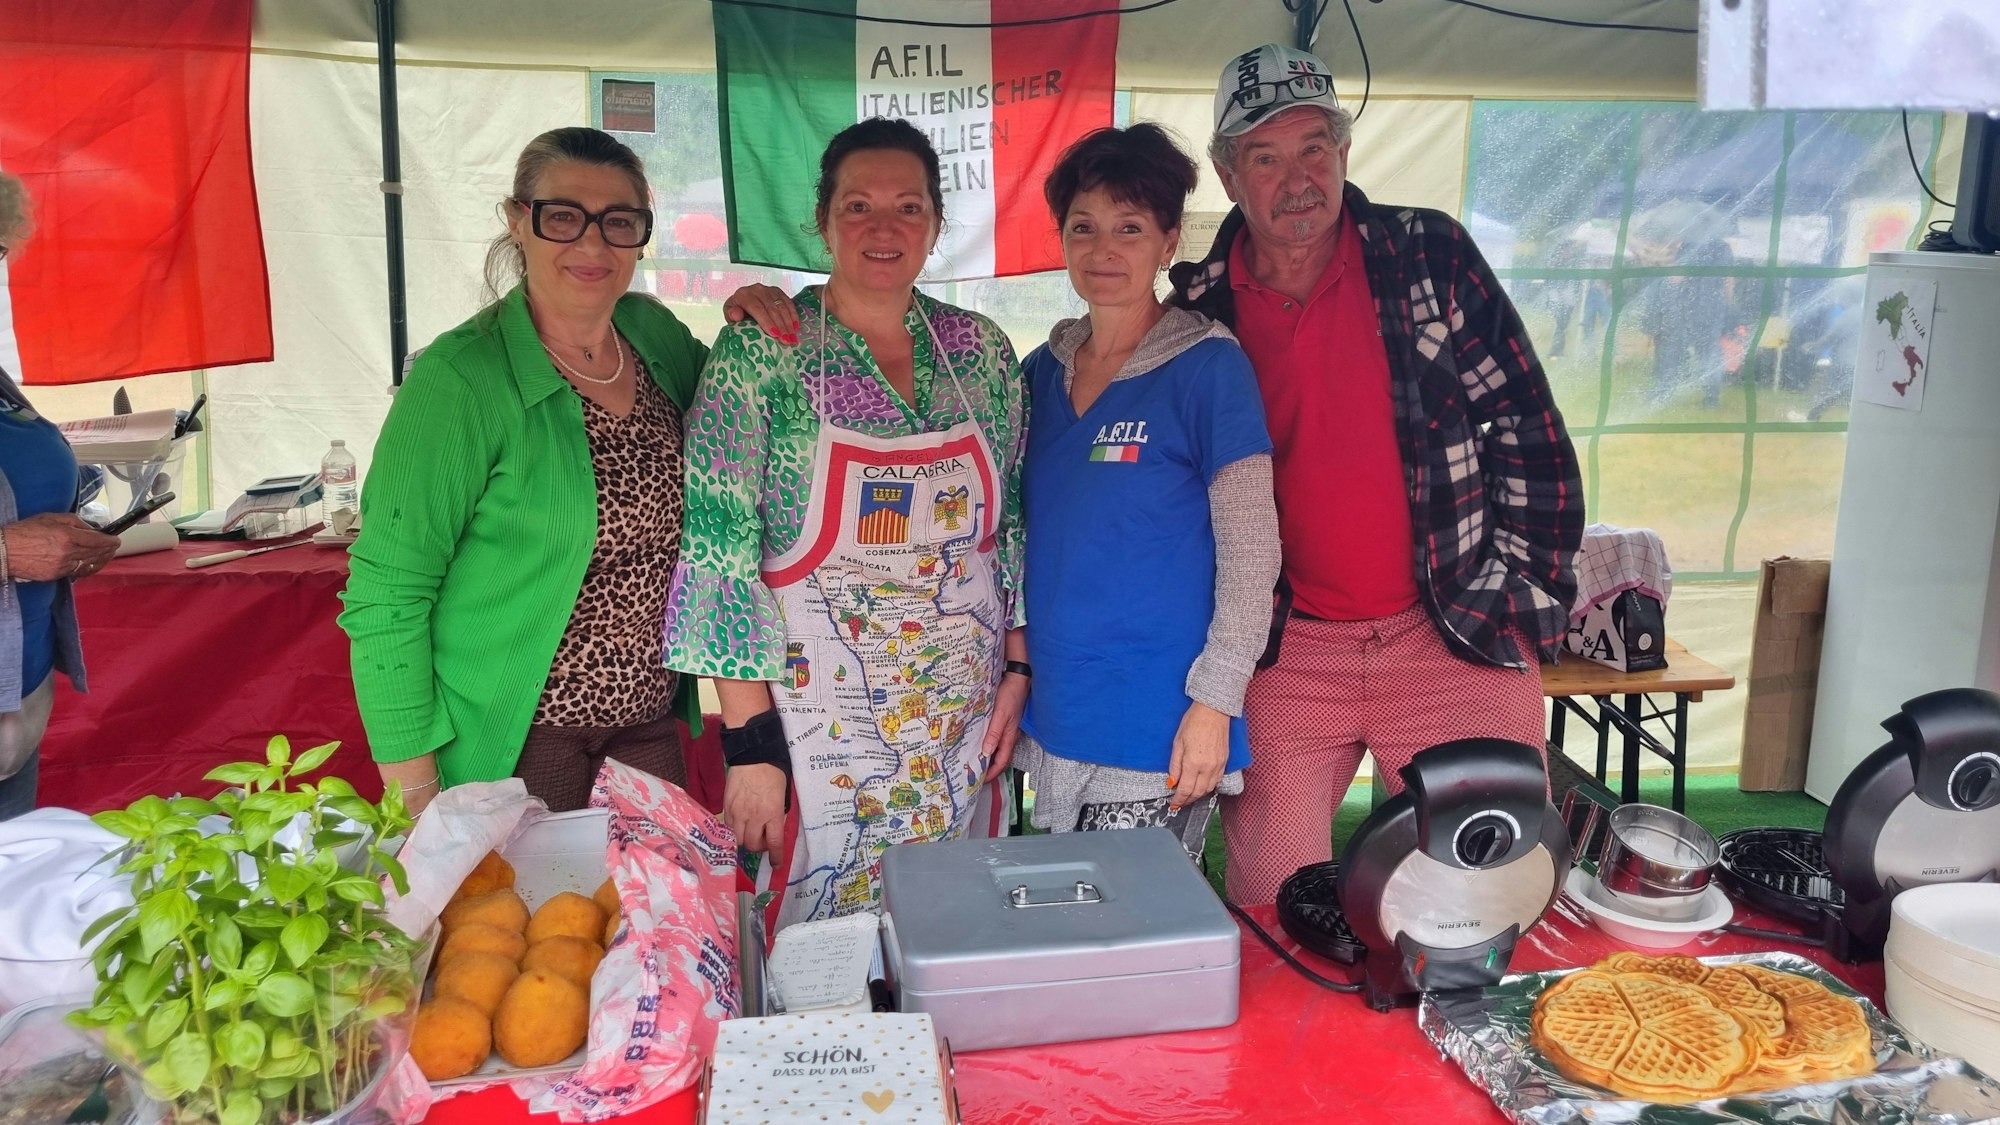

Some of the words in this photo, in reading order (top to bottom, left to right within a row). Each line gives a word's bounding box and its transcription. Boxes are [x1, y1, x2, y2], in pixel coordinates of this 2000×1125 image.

[870, 44, 963, 79] A.F.I.L
[862, 69, 1062, 117] ITALIENISCHER
[930, 119, 1009, 155] ILIEN
[939, 159, 986, 193] EIN
[1907, 307, 1926, 339] ITALIA
[1092, 420, 1149, 444] A.F.I.L
[863, 458, 965, 479] CALABRIA
[865, 548, 907, 556] COSENZA
[840, 555, 892, 573] BASILICATA
[932, 634, 953, 643] GRECA
[887, 688, 916, 696] COSENZA
[796, 722, 824, 743] TIRRENO
[837, 832, 853, 870] MESSINA
[1437, 920, 1481, 930] SEVERIN
[783, 1045, 868, 1065] SCHÖN,
[772, 1067, 804, 1077] DASS
[810, 1067, 826, 1076] DU
[830, 1067, 848, 1076] DA
[851, 1064, 877, 1074] BIST
